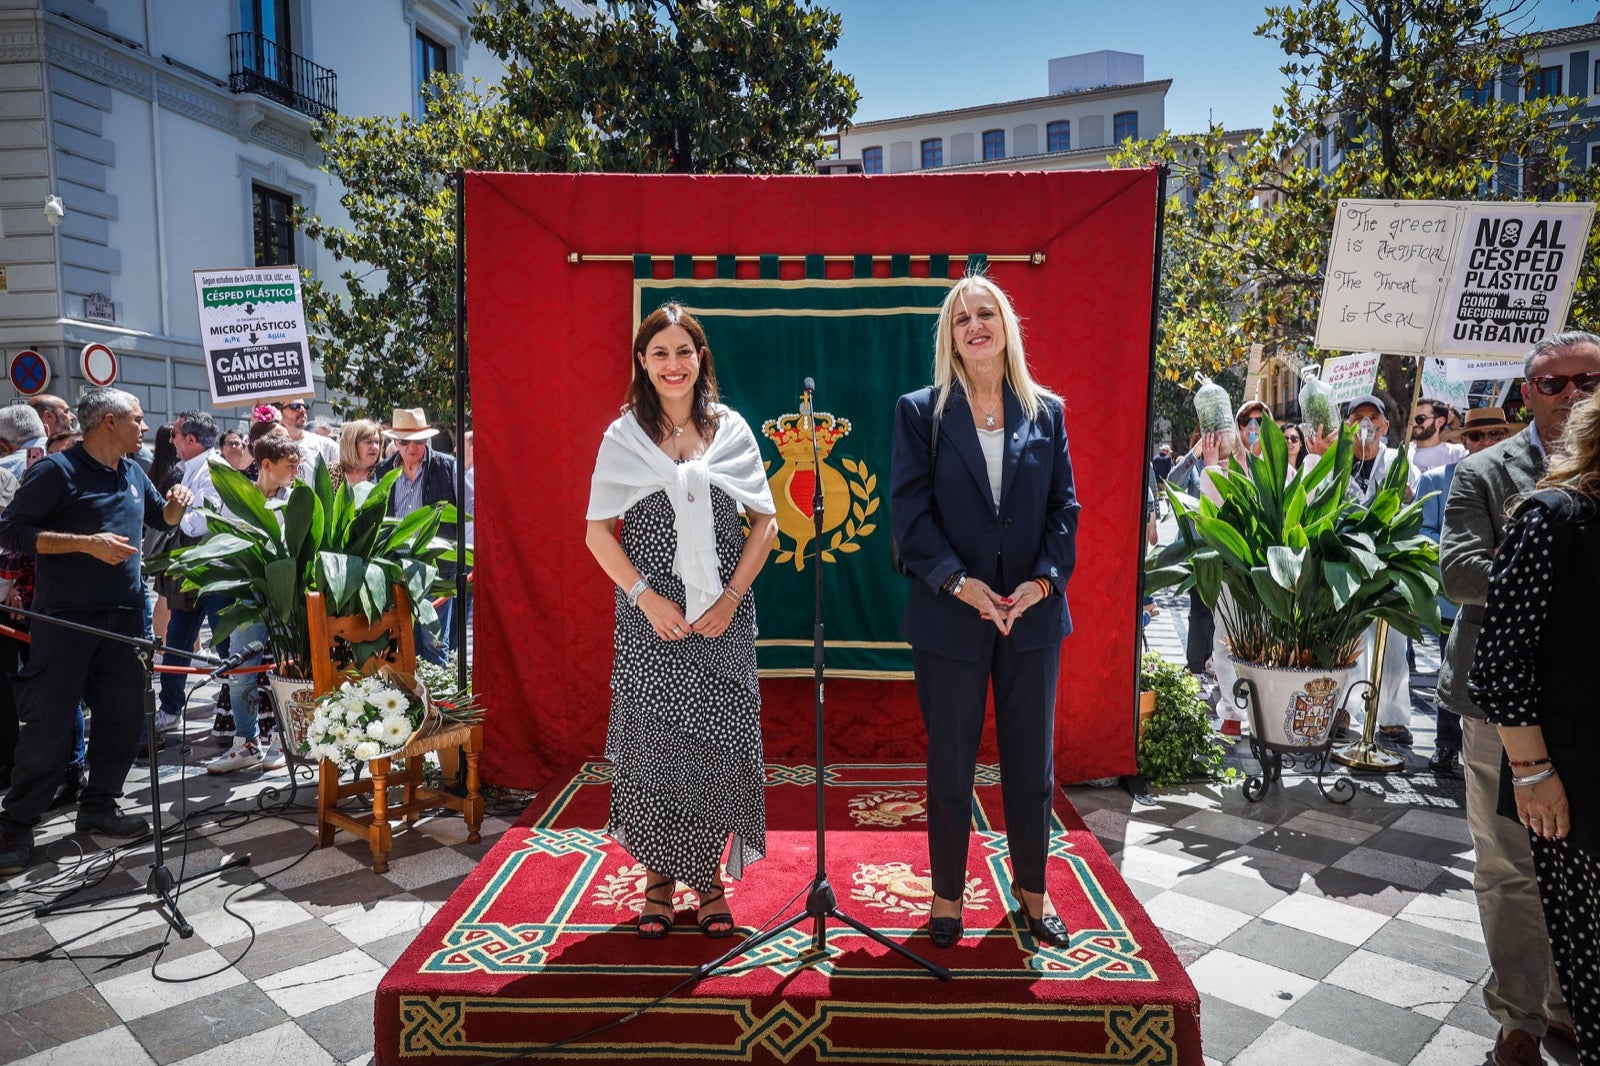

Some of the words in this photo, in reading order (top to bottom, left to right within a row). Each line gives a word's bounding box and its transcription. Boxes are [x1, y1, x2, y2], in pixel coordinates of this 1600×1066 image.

[1347, 208, 1378, 232] The
[1389, 218, 1446, 240] green
[1475, 218, 1523, 248] NO
[1526, 220, 1566, 249] AL
[1347, 238, 1364, 252] is
[1468, 247, 1563, 272] CÉSPED
[1334, 270, 1362, 292] The
[1374, 271, 1418, 295] Threat
[1464, 270, 1558, 291] PLÁSTICO
[206, 289, 244, 301] CÉSPED
[246, 286, 293, 299] PLÁSTICO
[1462, 296, 1498, 308] COMO
[1340, 304, 1358, 323] is
[1459, 307, 1547, 321] RECUBRIMIENTO
[210, 320, 297, 336] MICROPLÁSTICOS
[1453, 323, 1545, 344] URBANO
[267, 332, 287, 340] AGUA
[243, 345, 269, 353] PRODUCE:
[216, 350, 300, 374] CÁNCER
[1333, 361, 1359, 373] CALOR
[1363, 358, 1377, 367] QUE
[222, 374, 246, 383] TDAH,
[246, 368, 301, 380] INFERTILIDAD,
[1328, 373, 1344, 383] NOS
[227, 379, 292, 393] HIPOTIROIDISMO,
